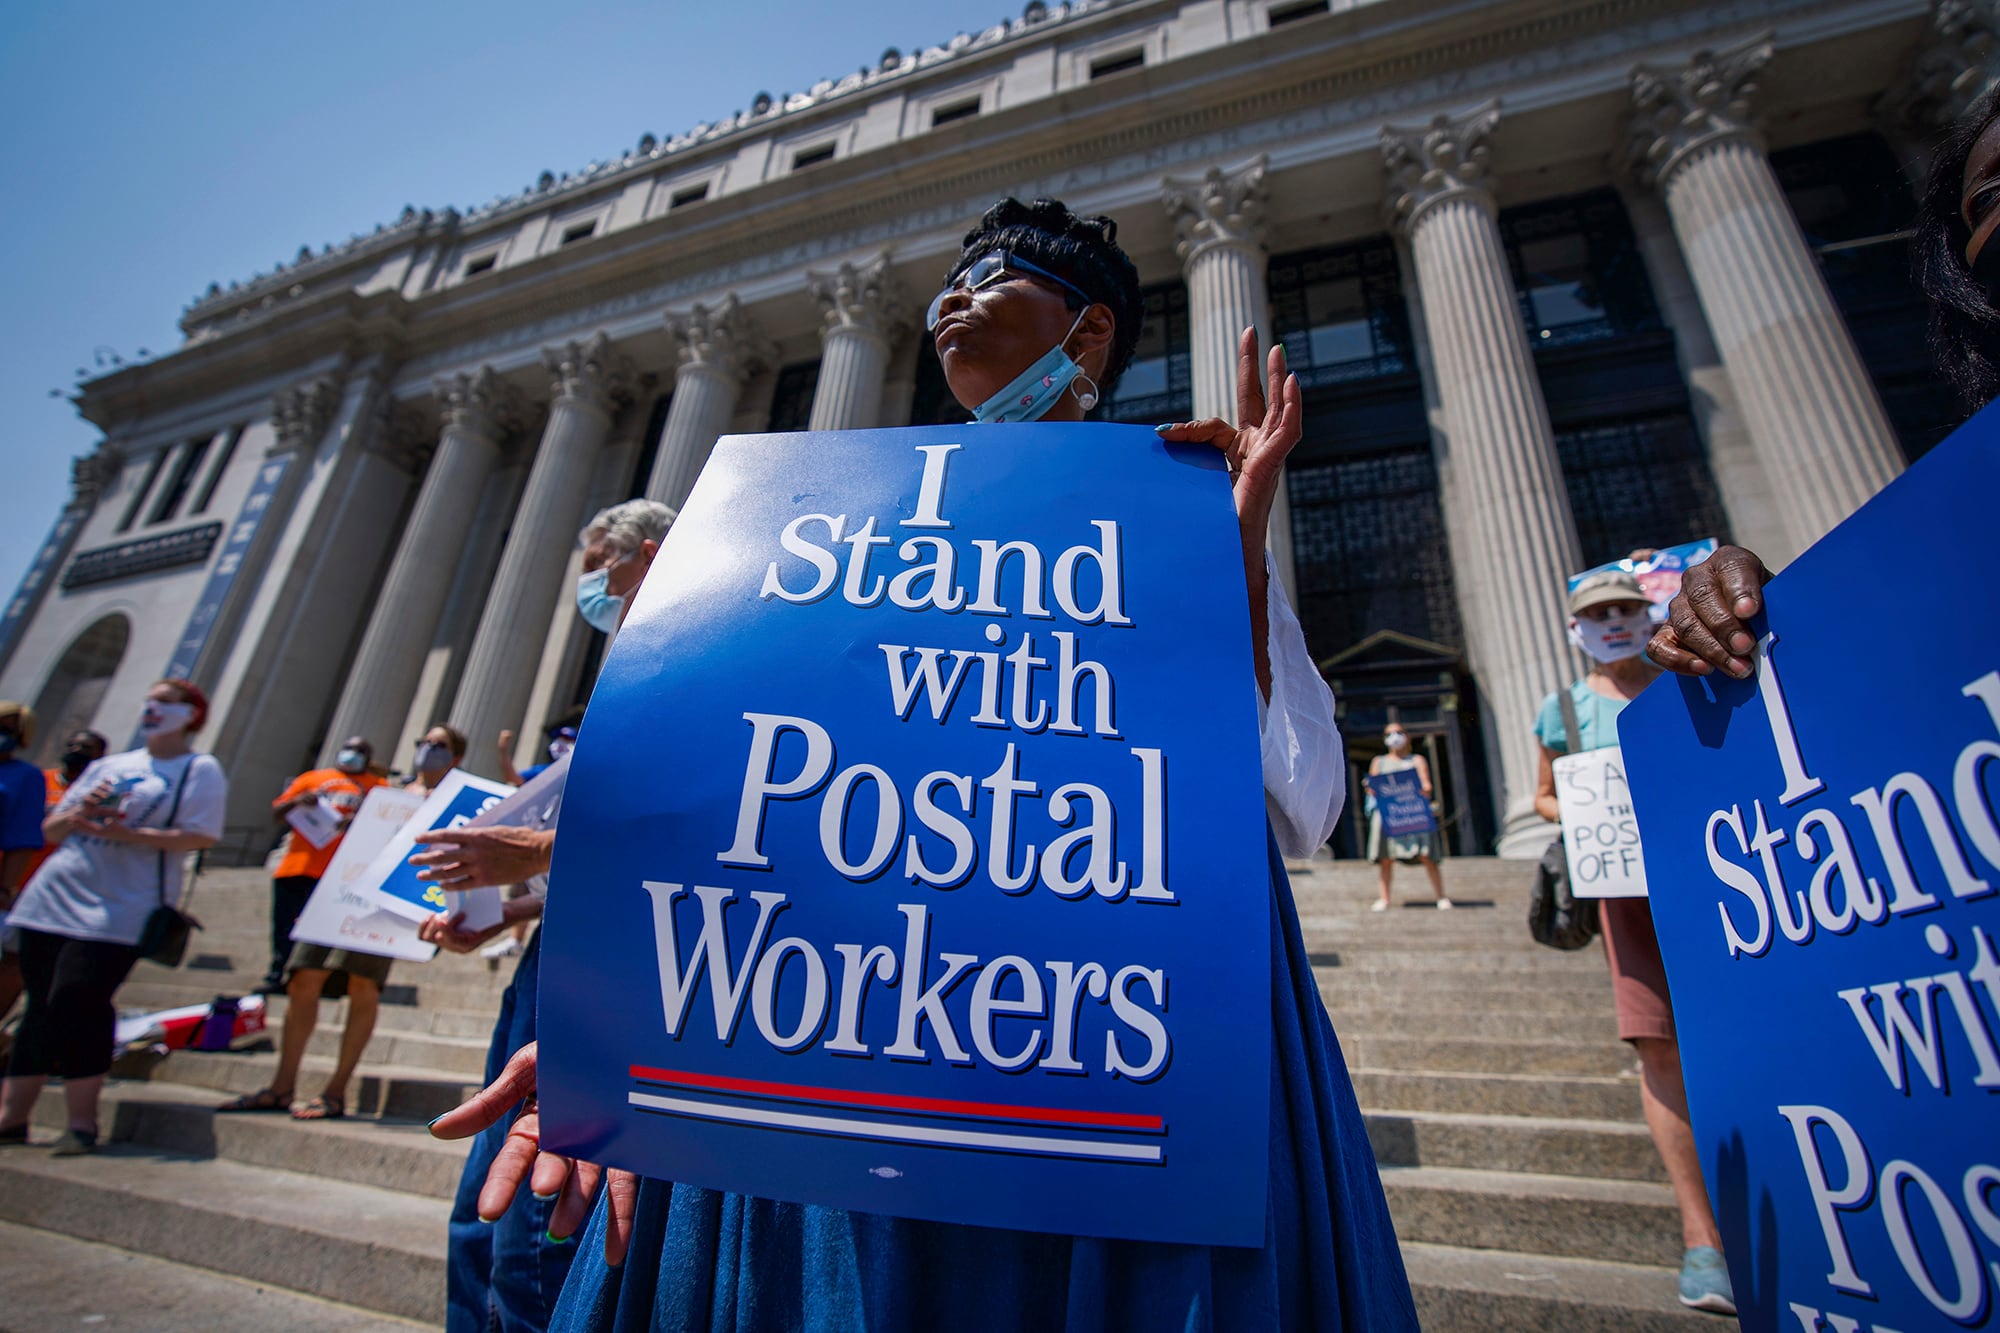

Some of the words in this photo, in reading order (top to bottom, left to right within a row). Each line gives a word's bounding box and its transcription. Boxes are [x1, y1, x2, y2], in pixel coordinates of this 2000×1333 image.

[900, 444, 960, 527] I
[760, 510, 1132, 624] Stand
[878, 624, 1120, 736] with
[1752, 631, 1827, 805] I
[717, 712, 1174, 900] Postal
[1575, 820, 1639, 850] POS
[1577, 848, 1637, 883] OFF
[642, 881, 1168, 1078] Workers
